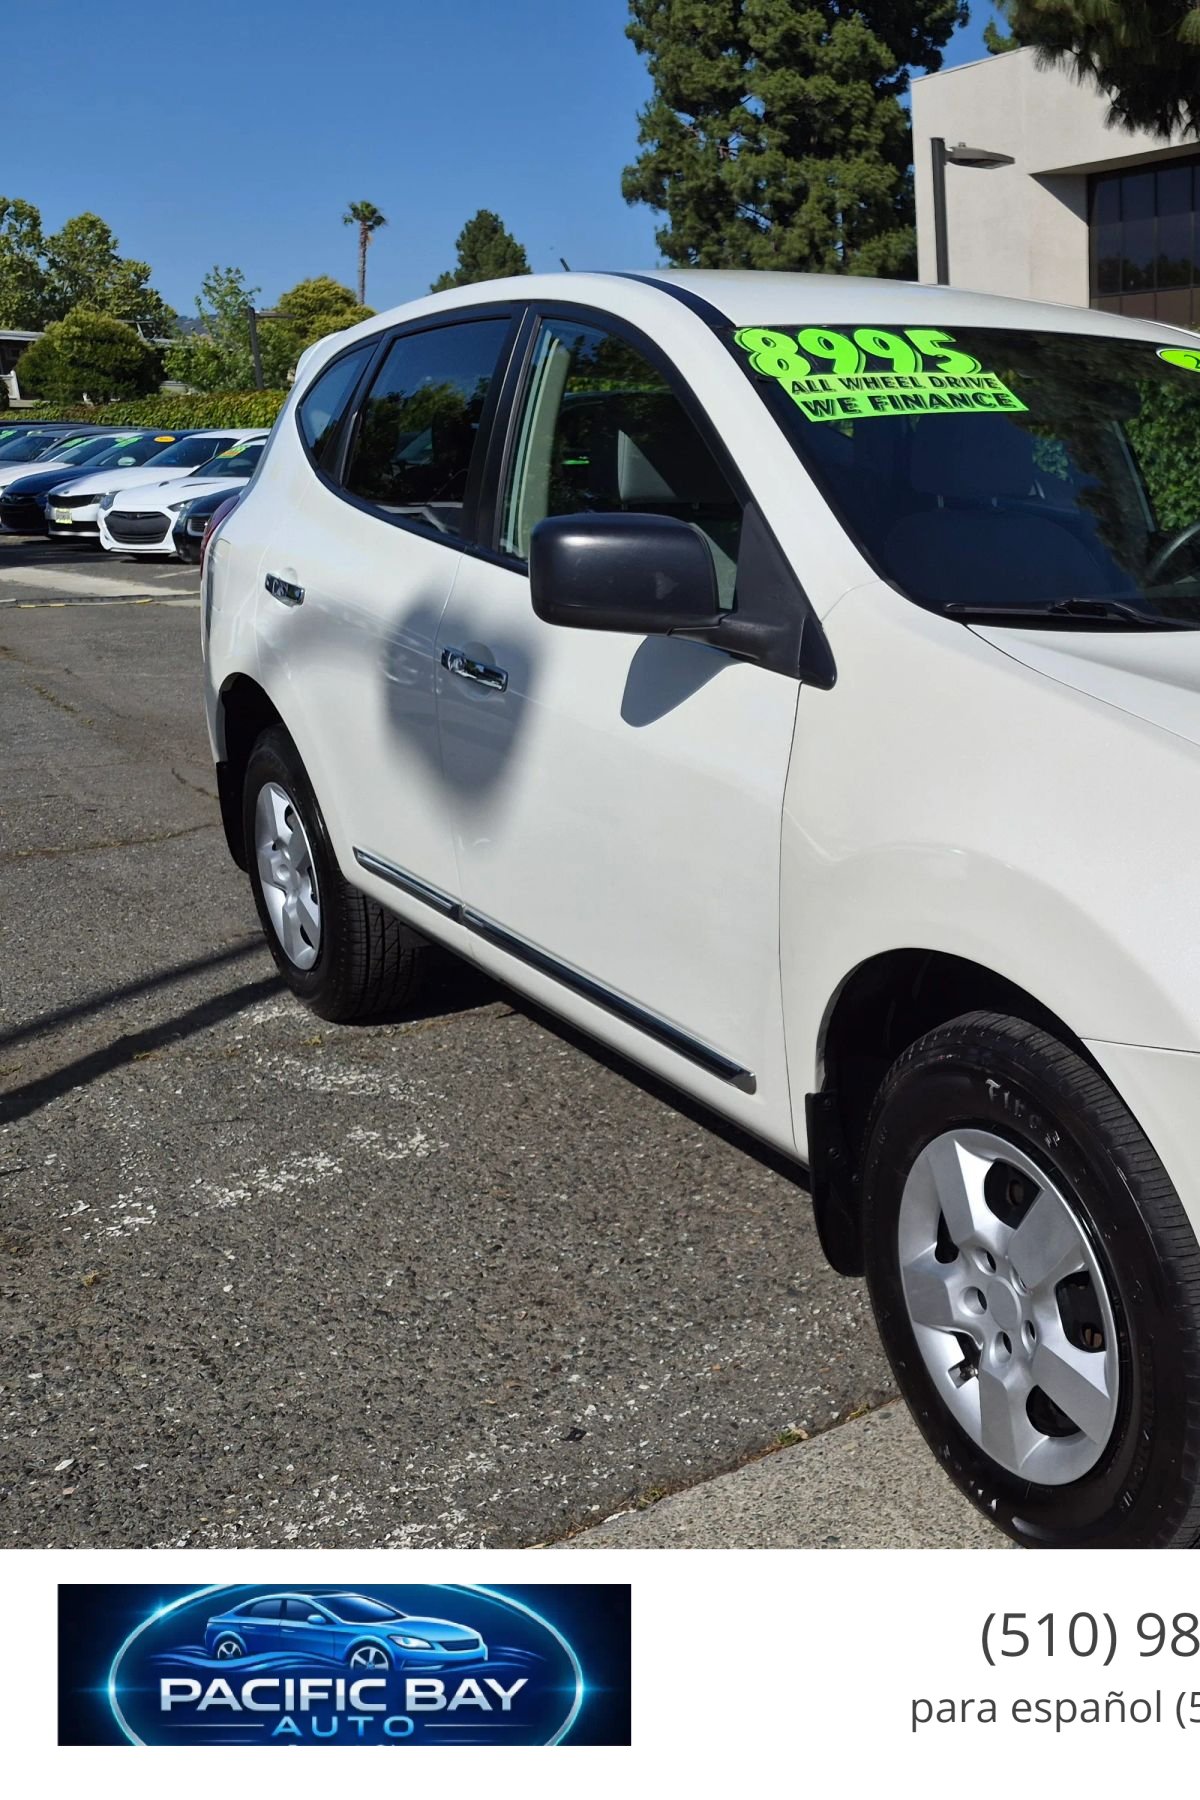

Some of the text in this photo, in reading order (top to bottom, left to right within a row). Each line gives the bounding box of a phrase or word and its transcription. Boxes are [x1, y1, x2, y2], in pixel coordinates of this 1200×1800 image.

[733, 327, 982, 378] 8995
[791, 375, 1000, 395] ALL WHEEL DRIVE
[800, 391, 1018, 418] WE FINANCE
